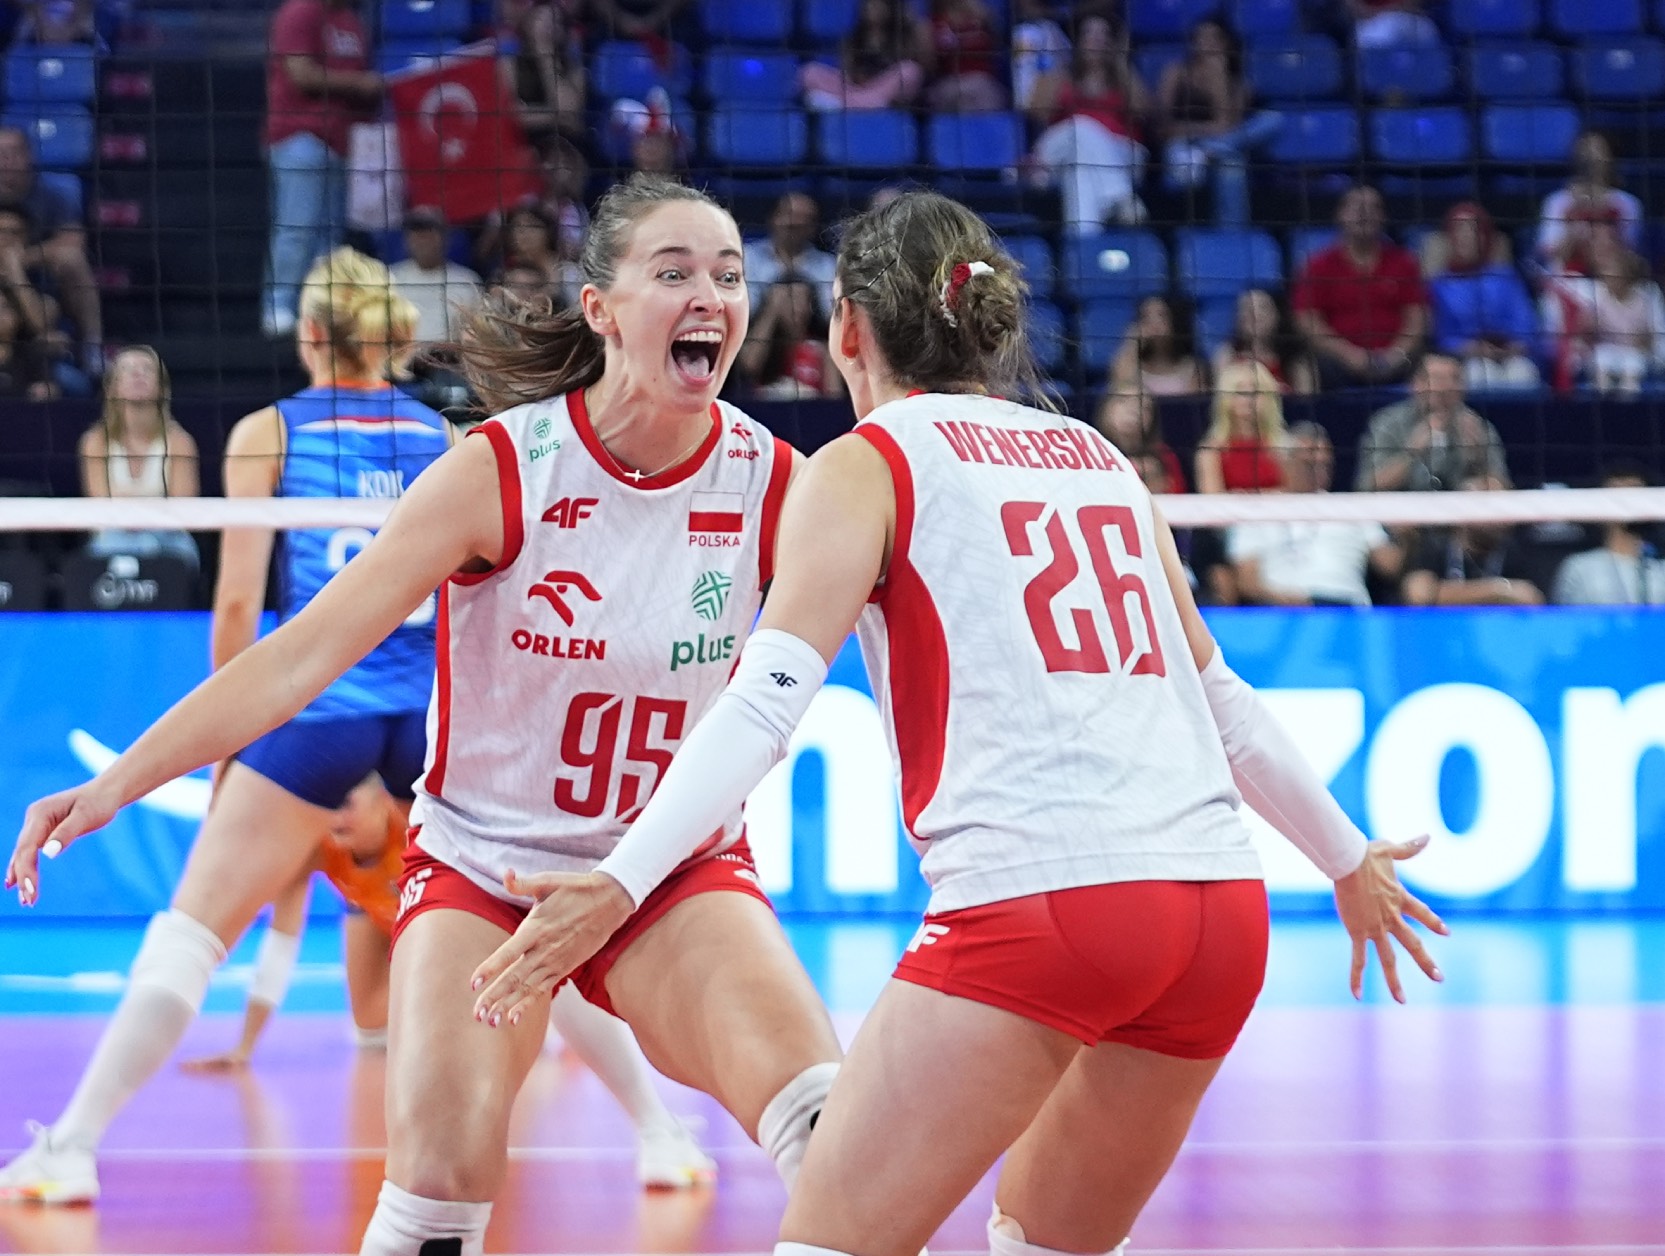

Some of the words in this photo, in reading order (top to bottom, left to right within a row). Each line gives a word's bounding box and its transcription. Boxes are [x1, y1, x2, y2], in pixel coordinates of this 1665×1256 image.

[529, 438, 561, 463] plus
[933, 421, 1124, 472] WENERSKA
[541, 497, 599, 528] 4F
[688, 535, 741, 547] POLSKA
[1000, 500, 1166, 678] 26
[511, 629, 606, 660] ORLEN
[670, 633, 735, 671] plus
[769, 672, 798, 687] 4F
[554, 691, 687, 824] 95
